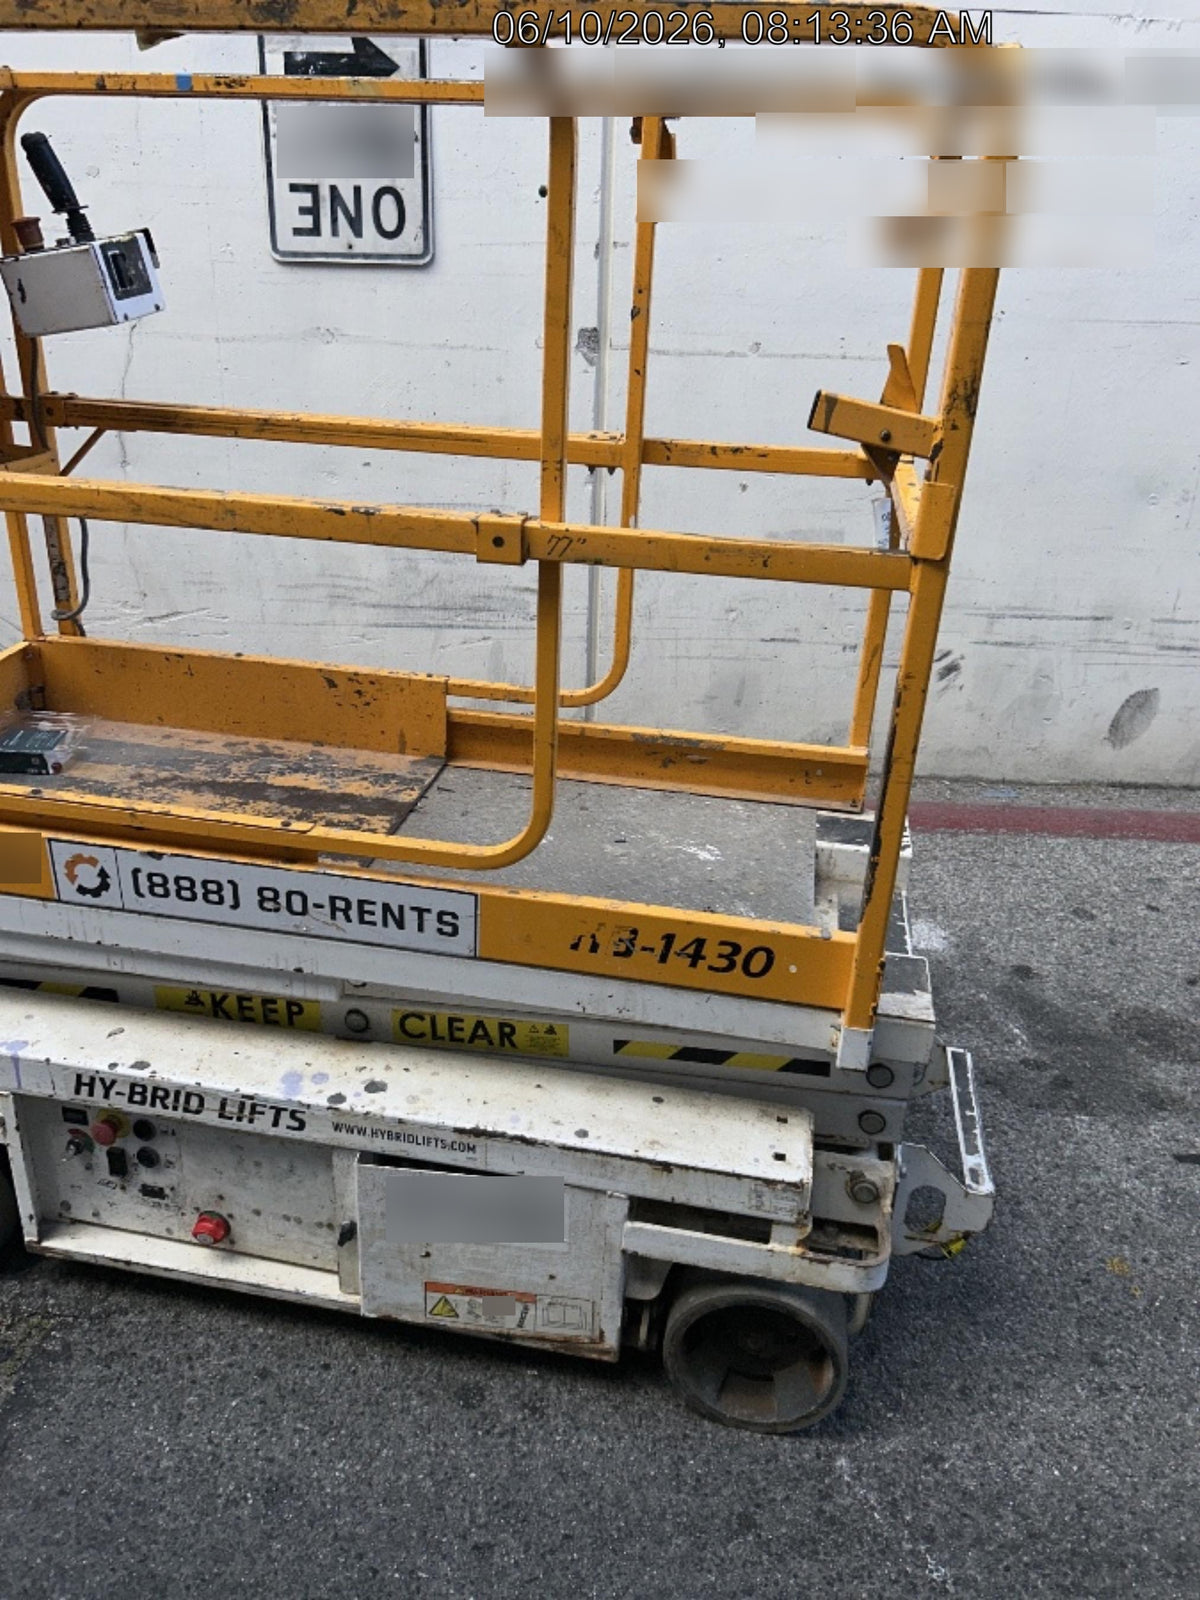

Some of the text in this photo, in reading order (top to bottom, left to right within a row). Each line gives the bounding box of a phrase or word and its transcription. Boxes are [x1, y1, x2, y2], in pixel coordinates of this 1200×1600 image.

[289, 183, 406, 240] ONE
[131, 867, 459, 938] (888) 80-RENTS
[209, 993, 304, 1027] KEEP
[400, 1012, 517, 1049] CLEAR
[74, 1073, 307, 1132] HY-BRID LIFTS
[332, 1121, 477, 1154] WWW.HYBRIDLIFTS.COM
